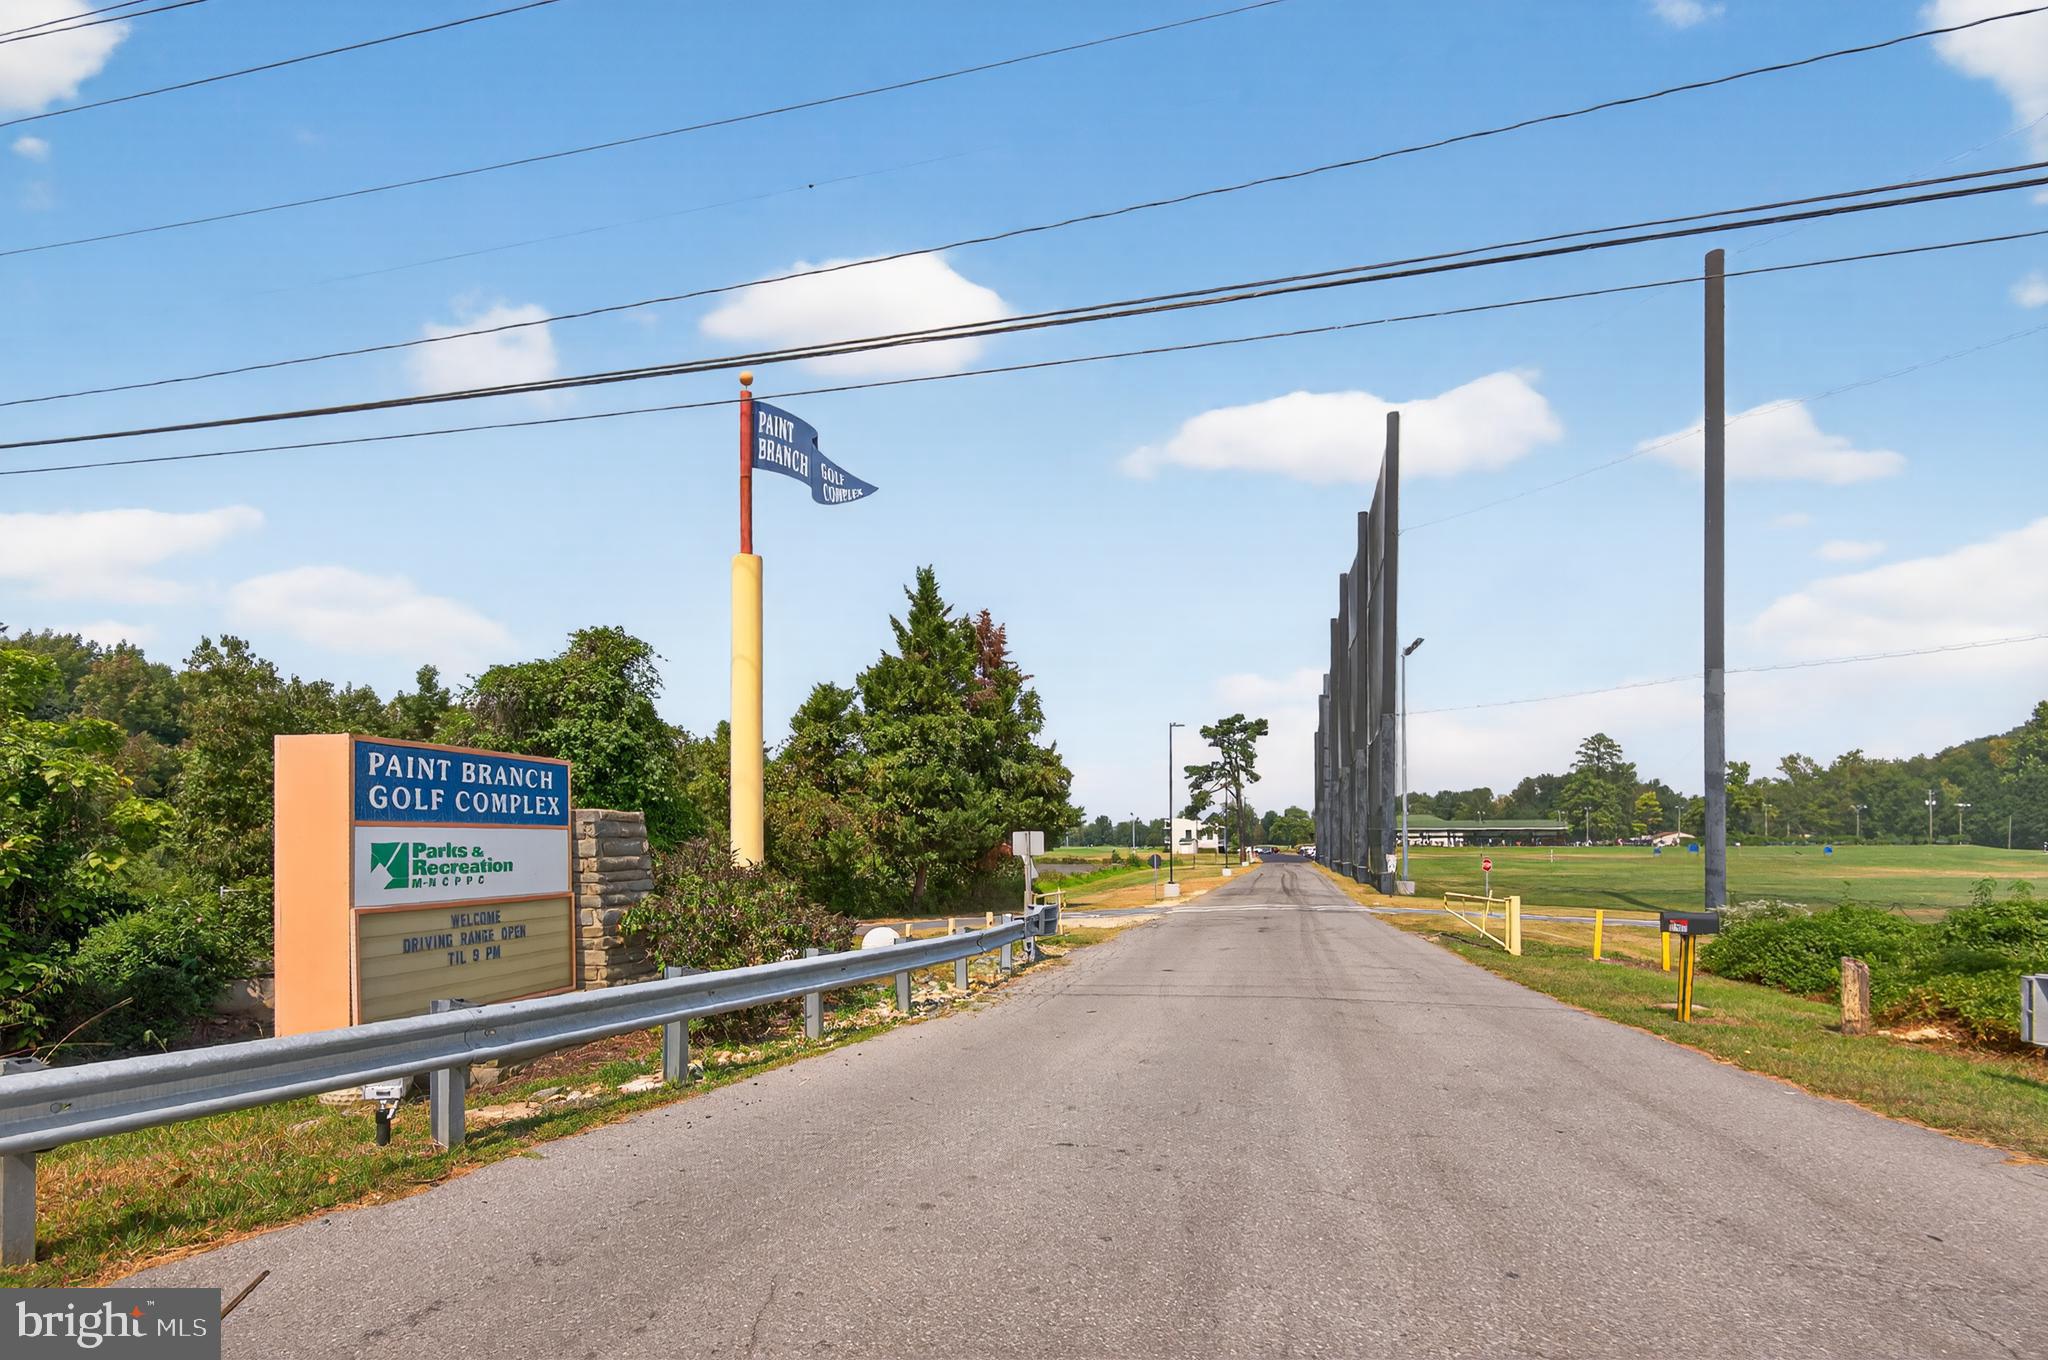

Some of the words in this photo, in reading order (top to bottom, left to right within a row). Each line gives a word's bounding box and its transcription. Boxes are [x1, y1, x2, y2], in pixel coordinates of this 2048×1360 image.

[758, 411, 794, 443] PAINT
[758, 438, 809, 478] BRANCH
[821, 463, 845, 485] GOLF
[823, 484, 863, 503] COMPLEX
[368, 752, 451, 781] PAINT
[461, 762, 553, 790] BRANCH
[369, 785, 444, 810] GOLF
[455, 791, 560, 816] COMPLEX
[413, 842, 468, 859] Parks
[471, 845, 484, 858] &
[413, 857, 514, 876] Recreation
[451, 910, 501, 928] WELCOME
[403, 934, 453, 954] DRIVING
[460, 929, 494, 945] RANGE
[501, 925, 526, 940] OPEN
[448, 952, 466, 966] TIL
[486, 945, 501, 961] PM
